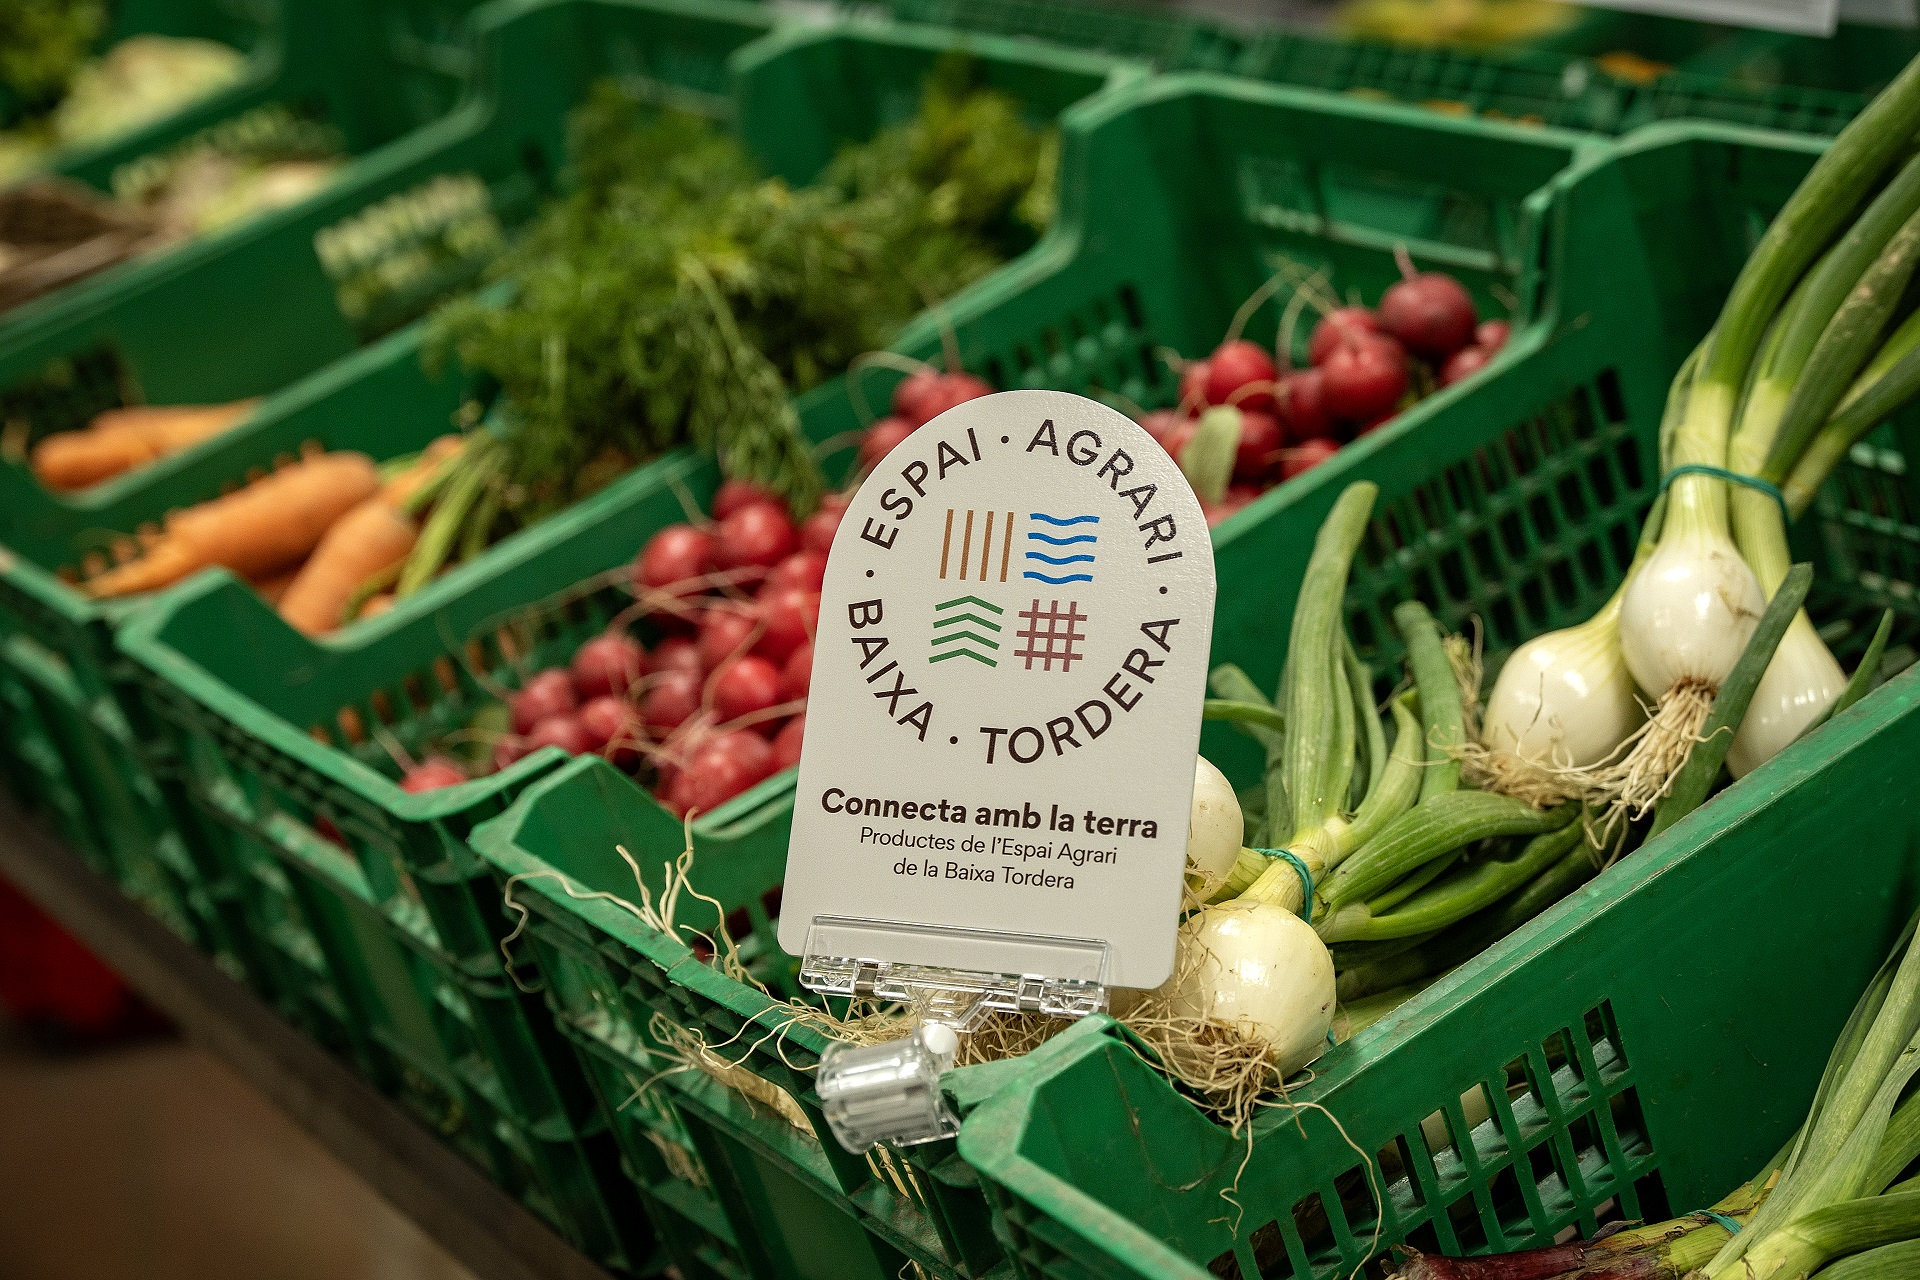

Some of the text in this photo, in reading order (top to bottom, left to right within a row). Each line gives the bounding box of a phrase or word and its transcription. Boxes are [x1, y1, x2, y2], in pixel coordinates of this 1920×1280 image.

[860, 418, 1183, 565] ESPAI AGRARI
[847, 598, 1181, 765] BAIXA TORDERA
[821, 787, 1158, 839] Connecta amb la terra
[860, 826, 956, 851] Productes
[960, 834, 986, 854] de
[1056, 842, 1118, 867] Agrari
[893, 857, 1075, 890] de la Baixa Tordera
